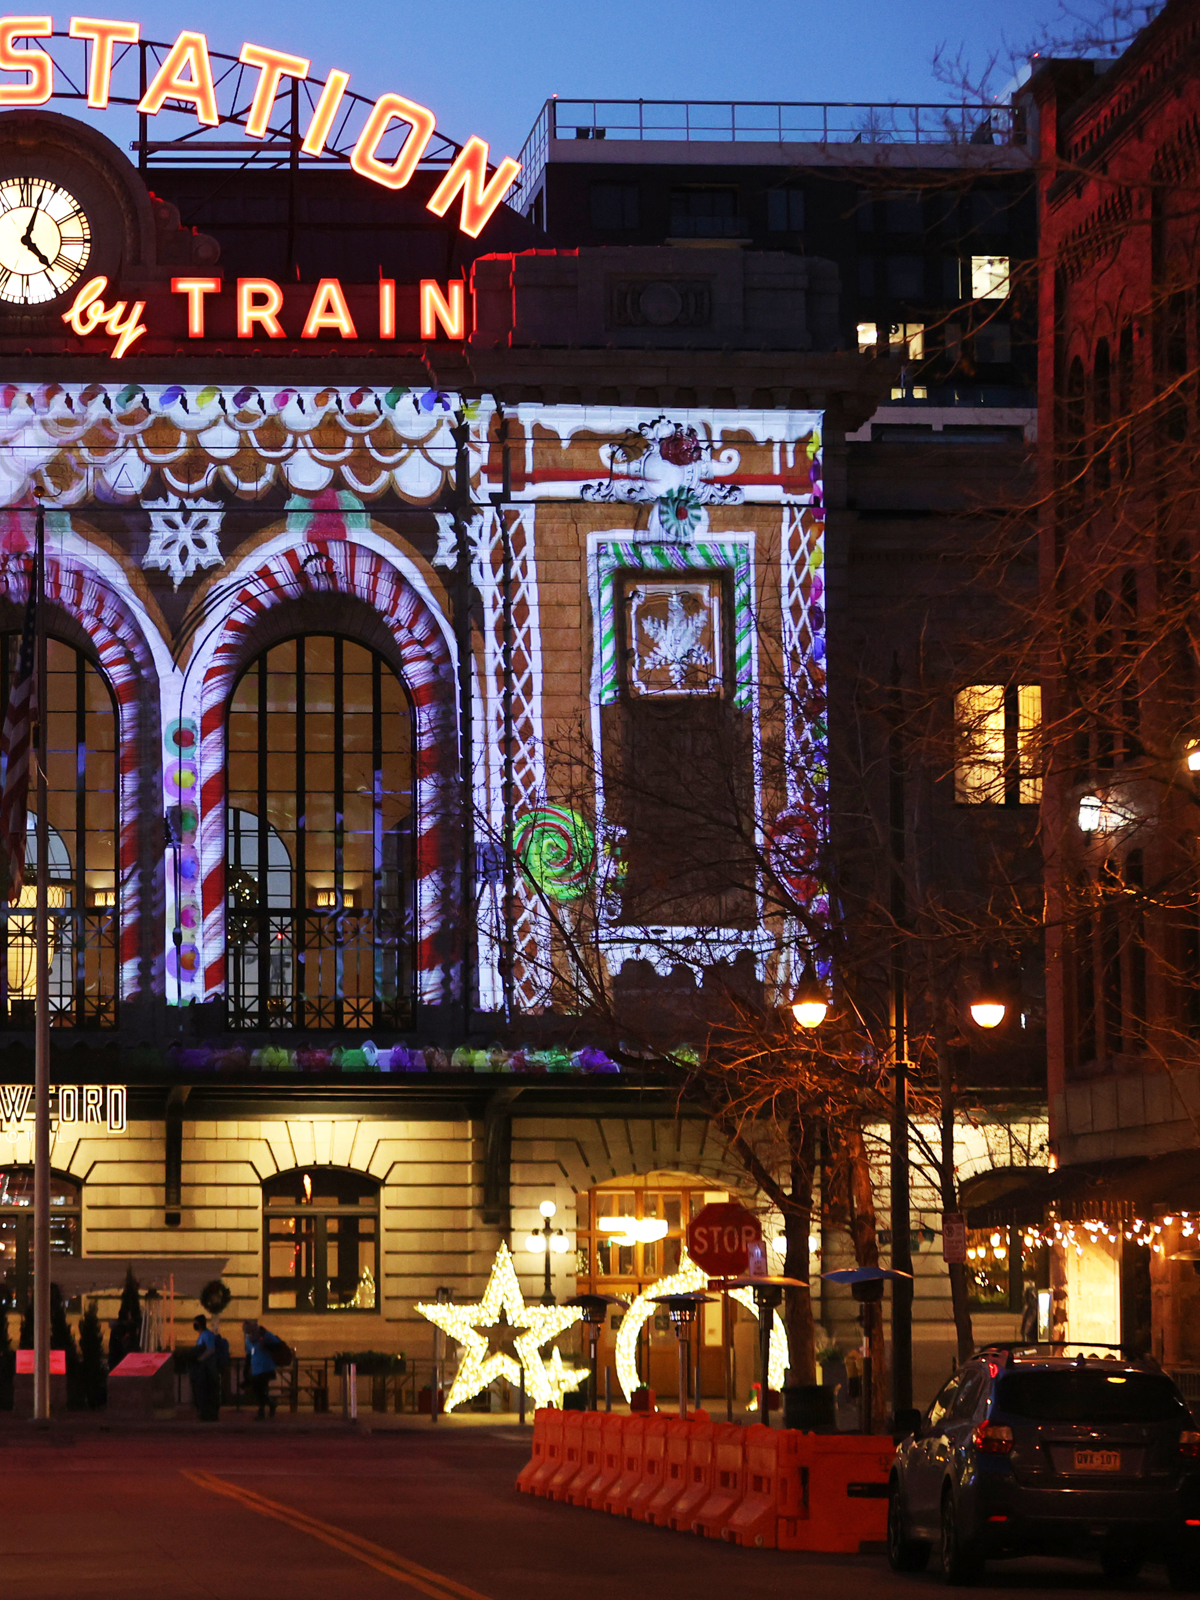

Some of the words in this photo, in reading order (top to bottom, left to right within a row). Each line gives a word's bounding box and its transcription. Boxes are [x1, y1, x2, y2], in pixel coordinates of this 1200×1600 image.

[61, 275, 147, 360] by
[171, 277, 466, 340] TRAIN
[29, 462, 292, 500] STATION
[693, 1225, 757, 1255] STOP
